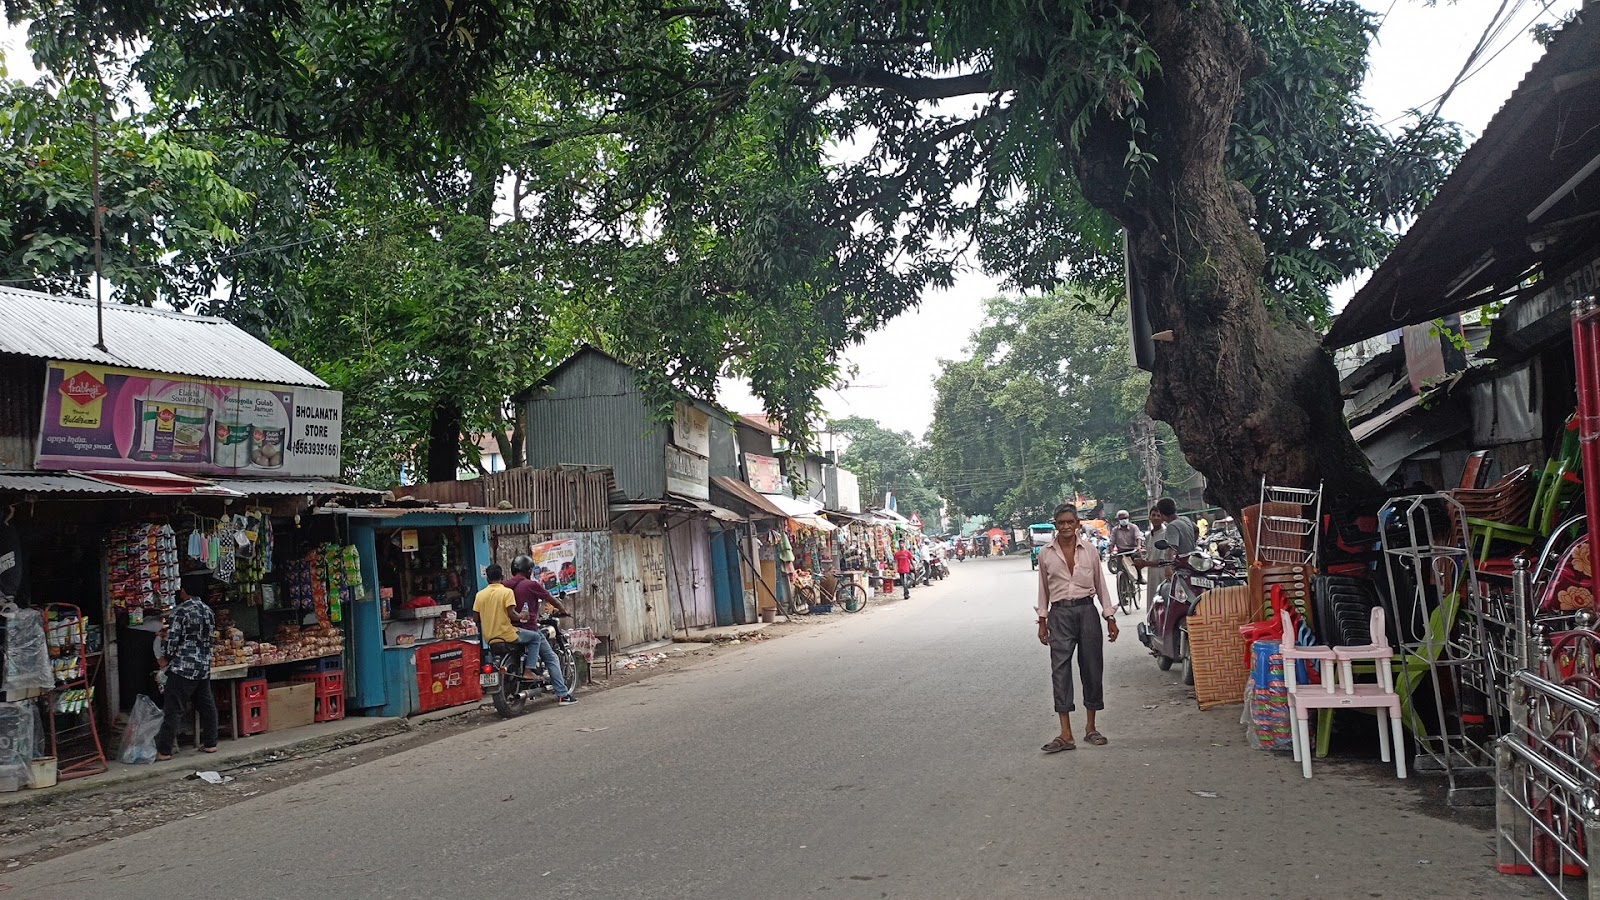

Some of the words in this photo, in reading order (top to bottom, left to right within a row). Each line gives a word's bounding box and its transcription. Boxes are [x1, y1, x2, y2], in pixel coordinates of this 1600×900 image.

[178, 388, 199, 397] Elaichi
[171, 395, 187, 403] Soan
[255, 398, 274, 407] Gulab
[253, 405, 274, 413] Jamun
[296, 405, 338, 421] BHOLANATH
[304, 424, 328, 438] STORE
